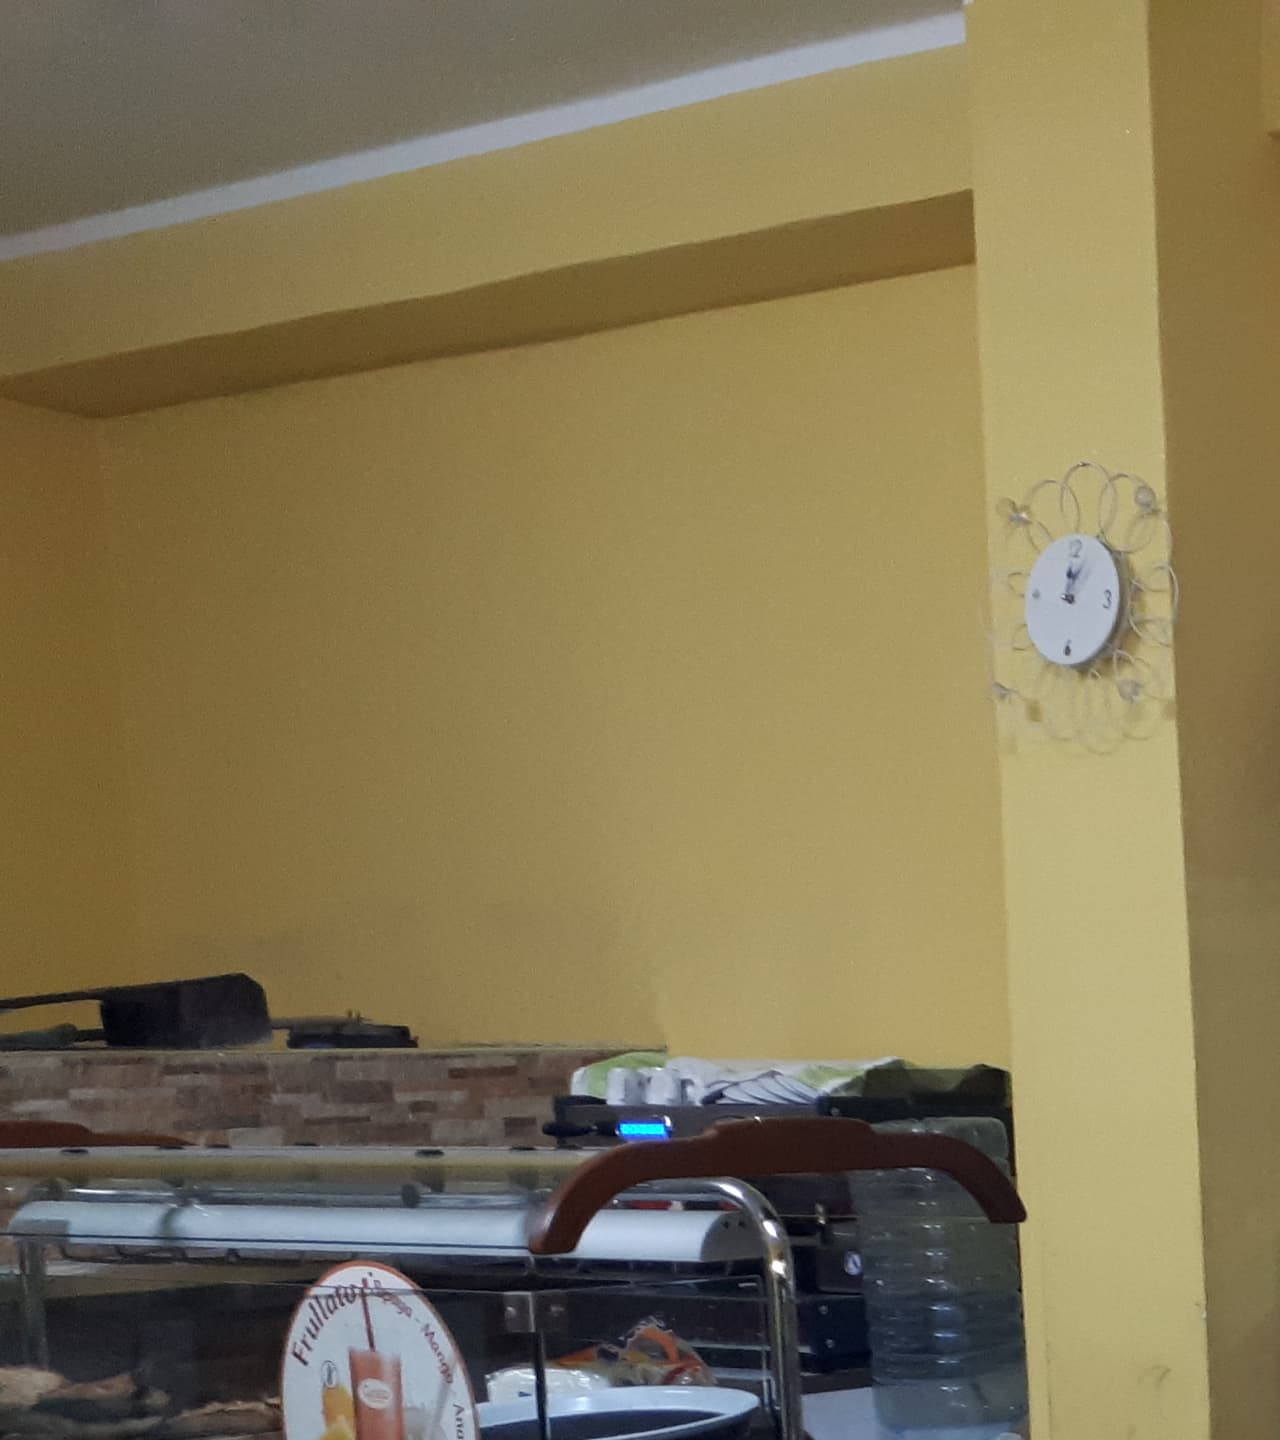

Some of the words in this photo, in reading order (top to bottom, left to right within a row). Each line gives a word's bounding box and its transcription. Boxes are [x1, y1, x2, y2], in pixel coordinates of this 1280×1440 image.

[1102, 588, 1113, 610] 3
[291, 1282, 358, 1367] Frullato
[420, 1323, 454, 1385] Mango
